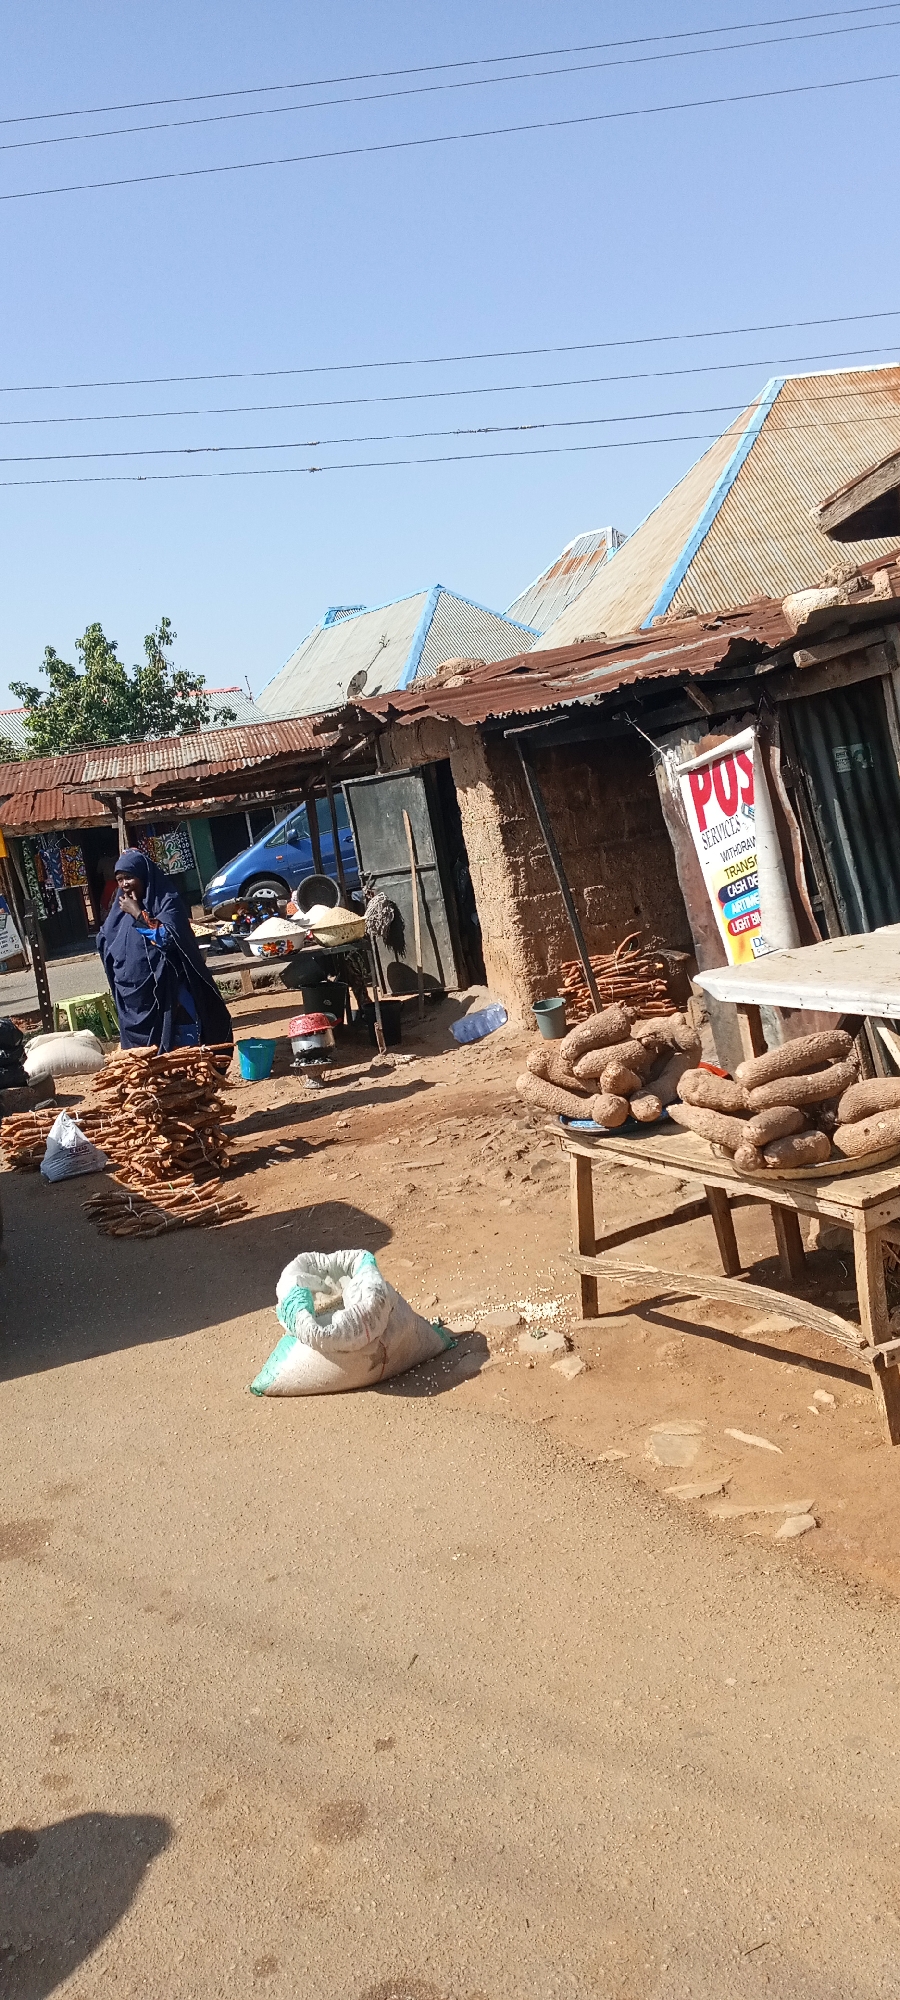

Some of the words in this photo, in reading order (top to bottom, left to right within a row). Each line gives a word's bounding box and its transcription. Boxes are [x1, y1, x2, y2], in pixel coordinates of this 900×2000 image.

[688, 750, 754, 833] POS
[701, 814, 741, 850] SERVICES
[727, 878, 748, 898] CASH
[730, 915, 750, 934] LIGHT
